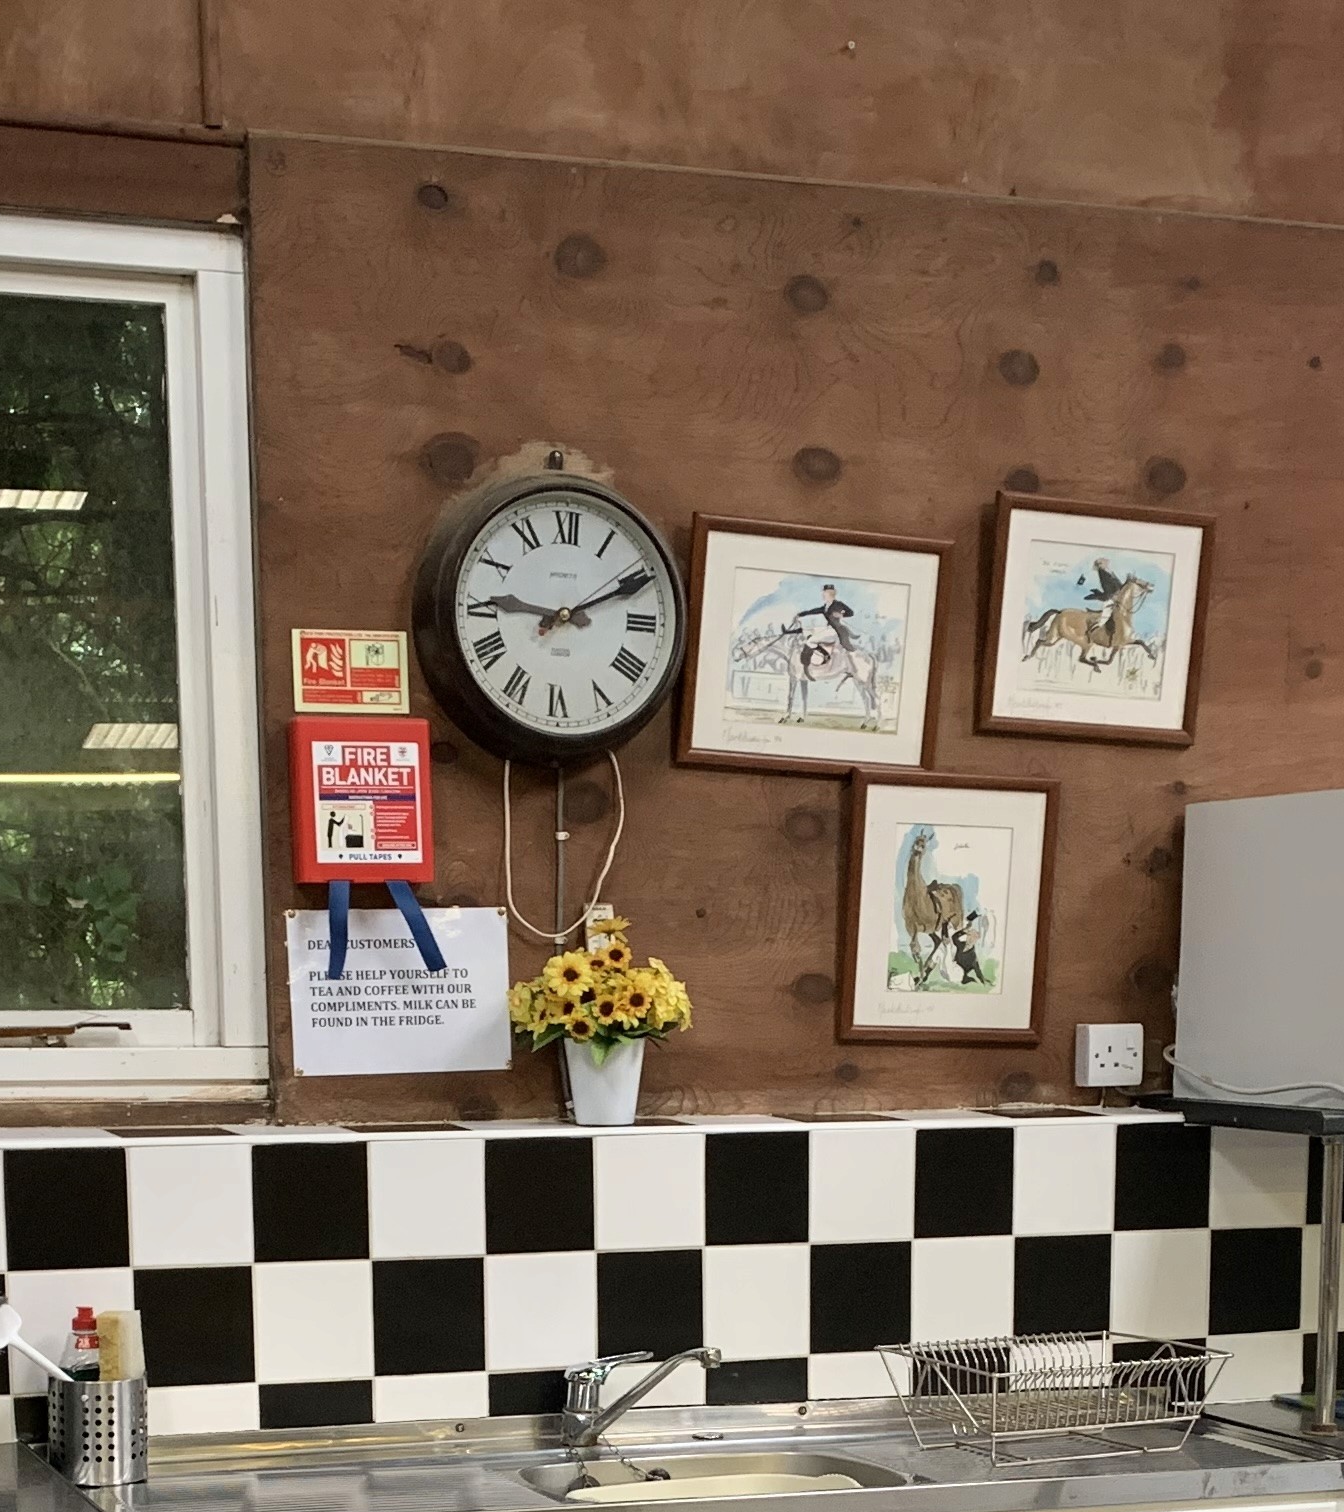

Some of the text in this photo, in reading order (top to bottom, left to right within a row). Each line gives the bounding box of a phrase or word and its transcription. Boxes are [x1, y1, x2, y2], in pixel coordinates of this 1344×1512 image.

[344, 747, 388, 766] FIRE
[321, 767, 411, 786] BLANKET
[348, 853, 392, 861] PULL TAPES
[307, 939, 332, 951] DEA
[356, 970, 387, 981] HELP
[389, 968, 449, 980] YOURSELF
[452, 968, 468, 978] TO
[310, 983, 472, 997] TEA AND COFFEE WITH OUR
[310, 998, 477, 1012] COMPLIMENTS. MILK CAN BE
[311, 1015, 445, 1028] FOUND IN THE FRIDGE.
